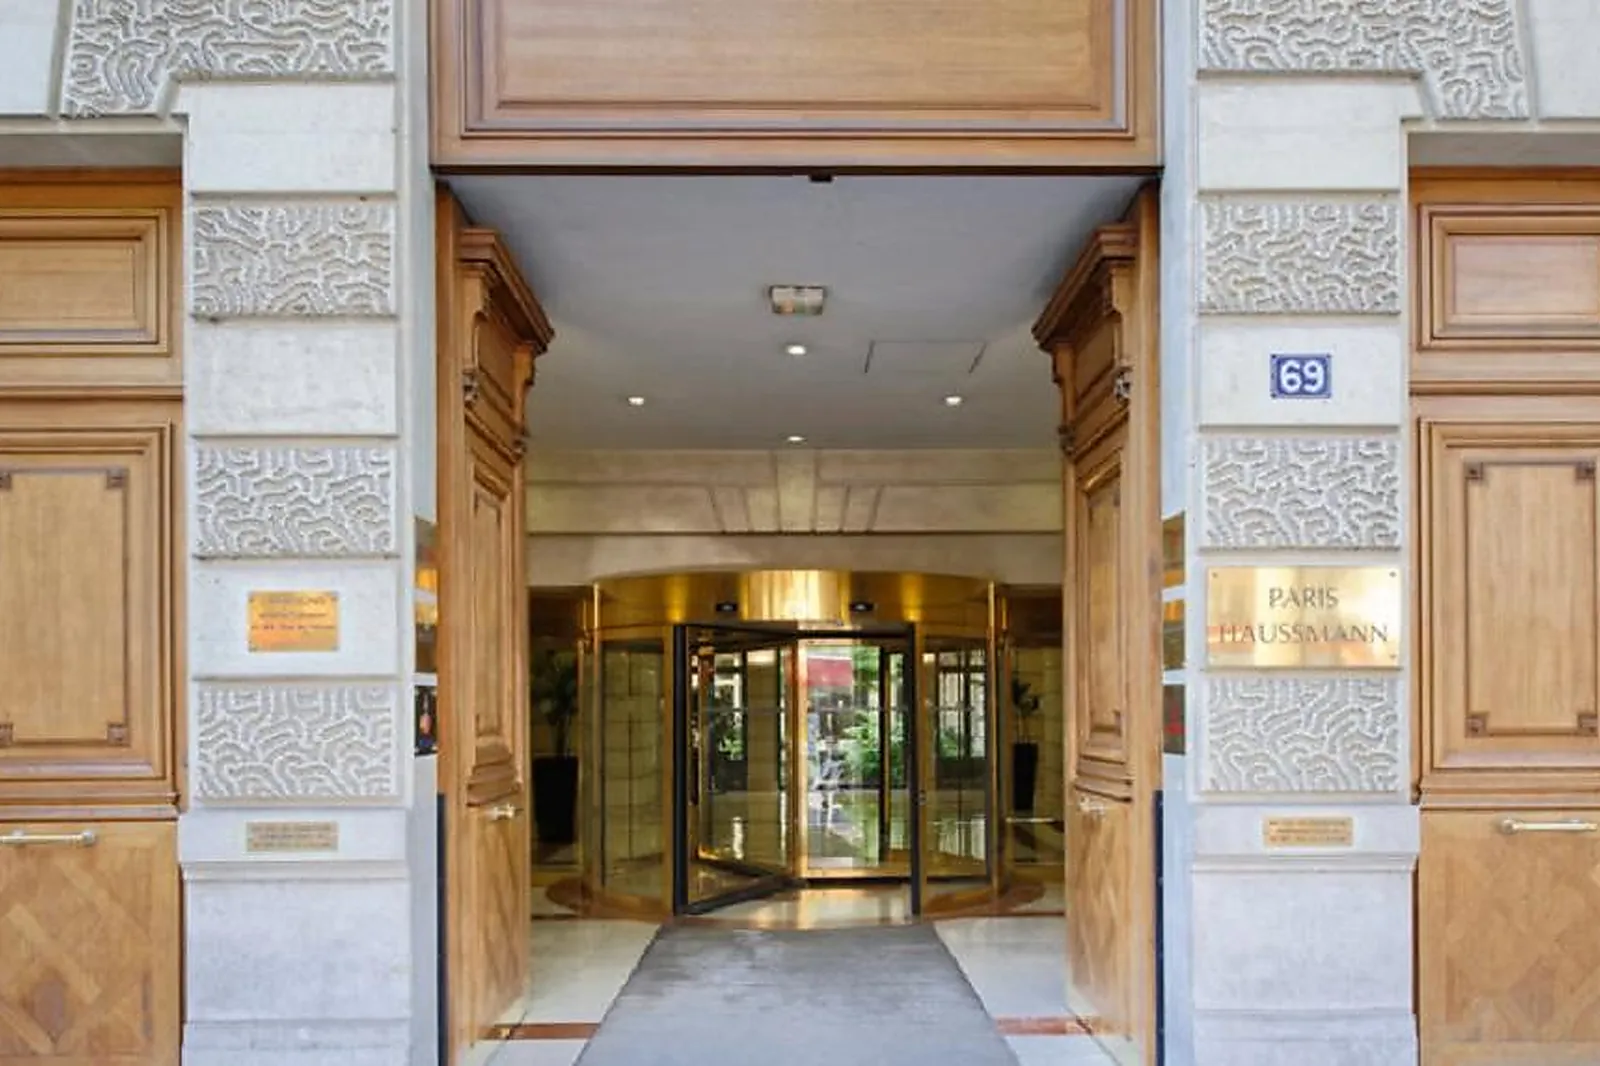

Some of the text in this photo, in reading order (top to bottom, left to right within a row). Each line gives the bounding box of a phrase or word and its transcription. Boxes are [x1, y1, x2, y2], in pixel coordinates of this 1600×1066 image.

[1280, 360, 1324, 392] 69
[1268, 587, 1339, 609] PARIS
[1219, 623, 1389, 644] HAUSSMANN
